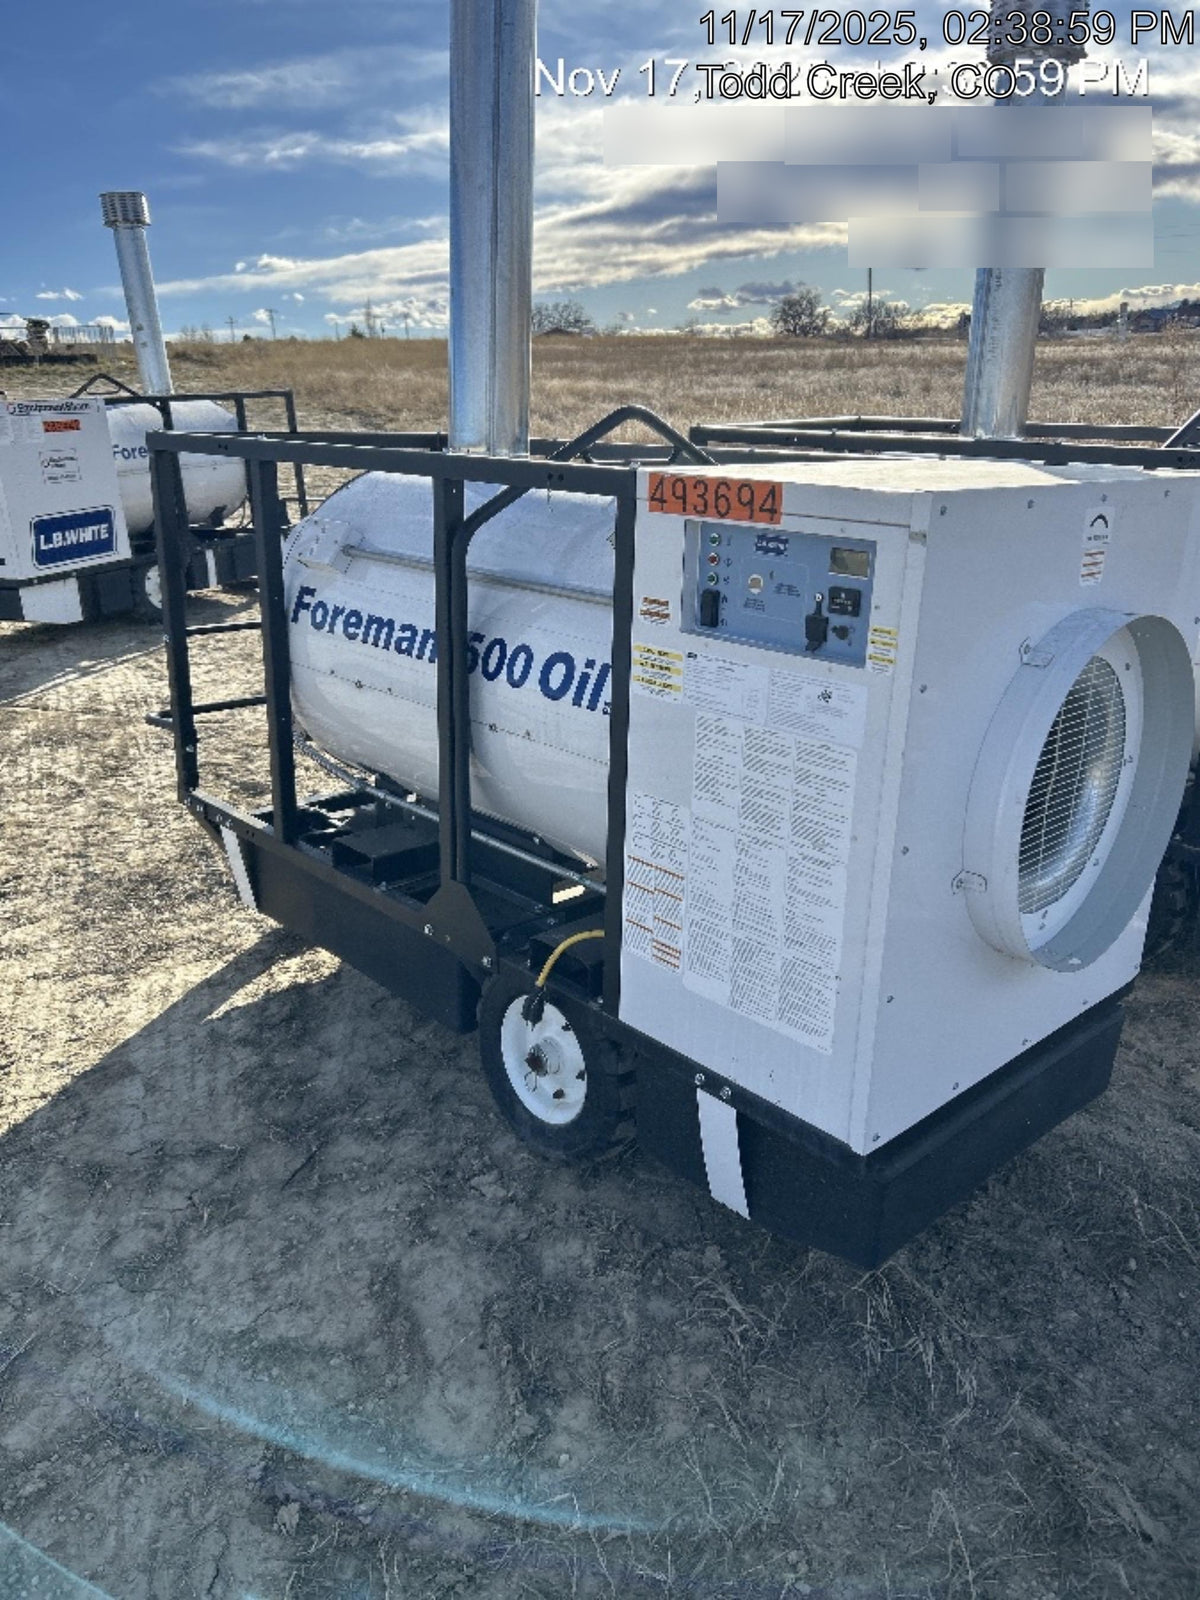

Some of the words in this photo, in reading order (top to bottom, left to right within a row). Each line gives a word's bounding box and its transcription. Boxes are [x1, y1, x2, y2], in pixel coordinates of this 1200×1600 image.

[112, 444, 147, 460] Fore
[650, 475, 778, 522] 493694
[291, 585, 438, 664] Foreman
[539, 651, 612, 712] Oil
